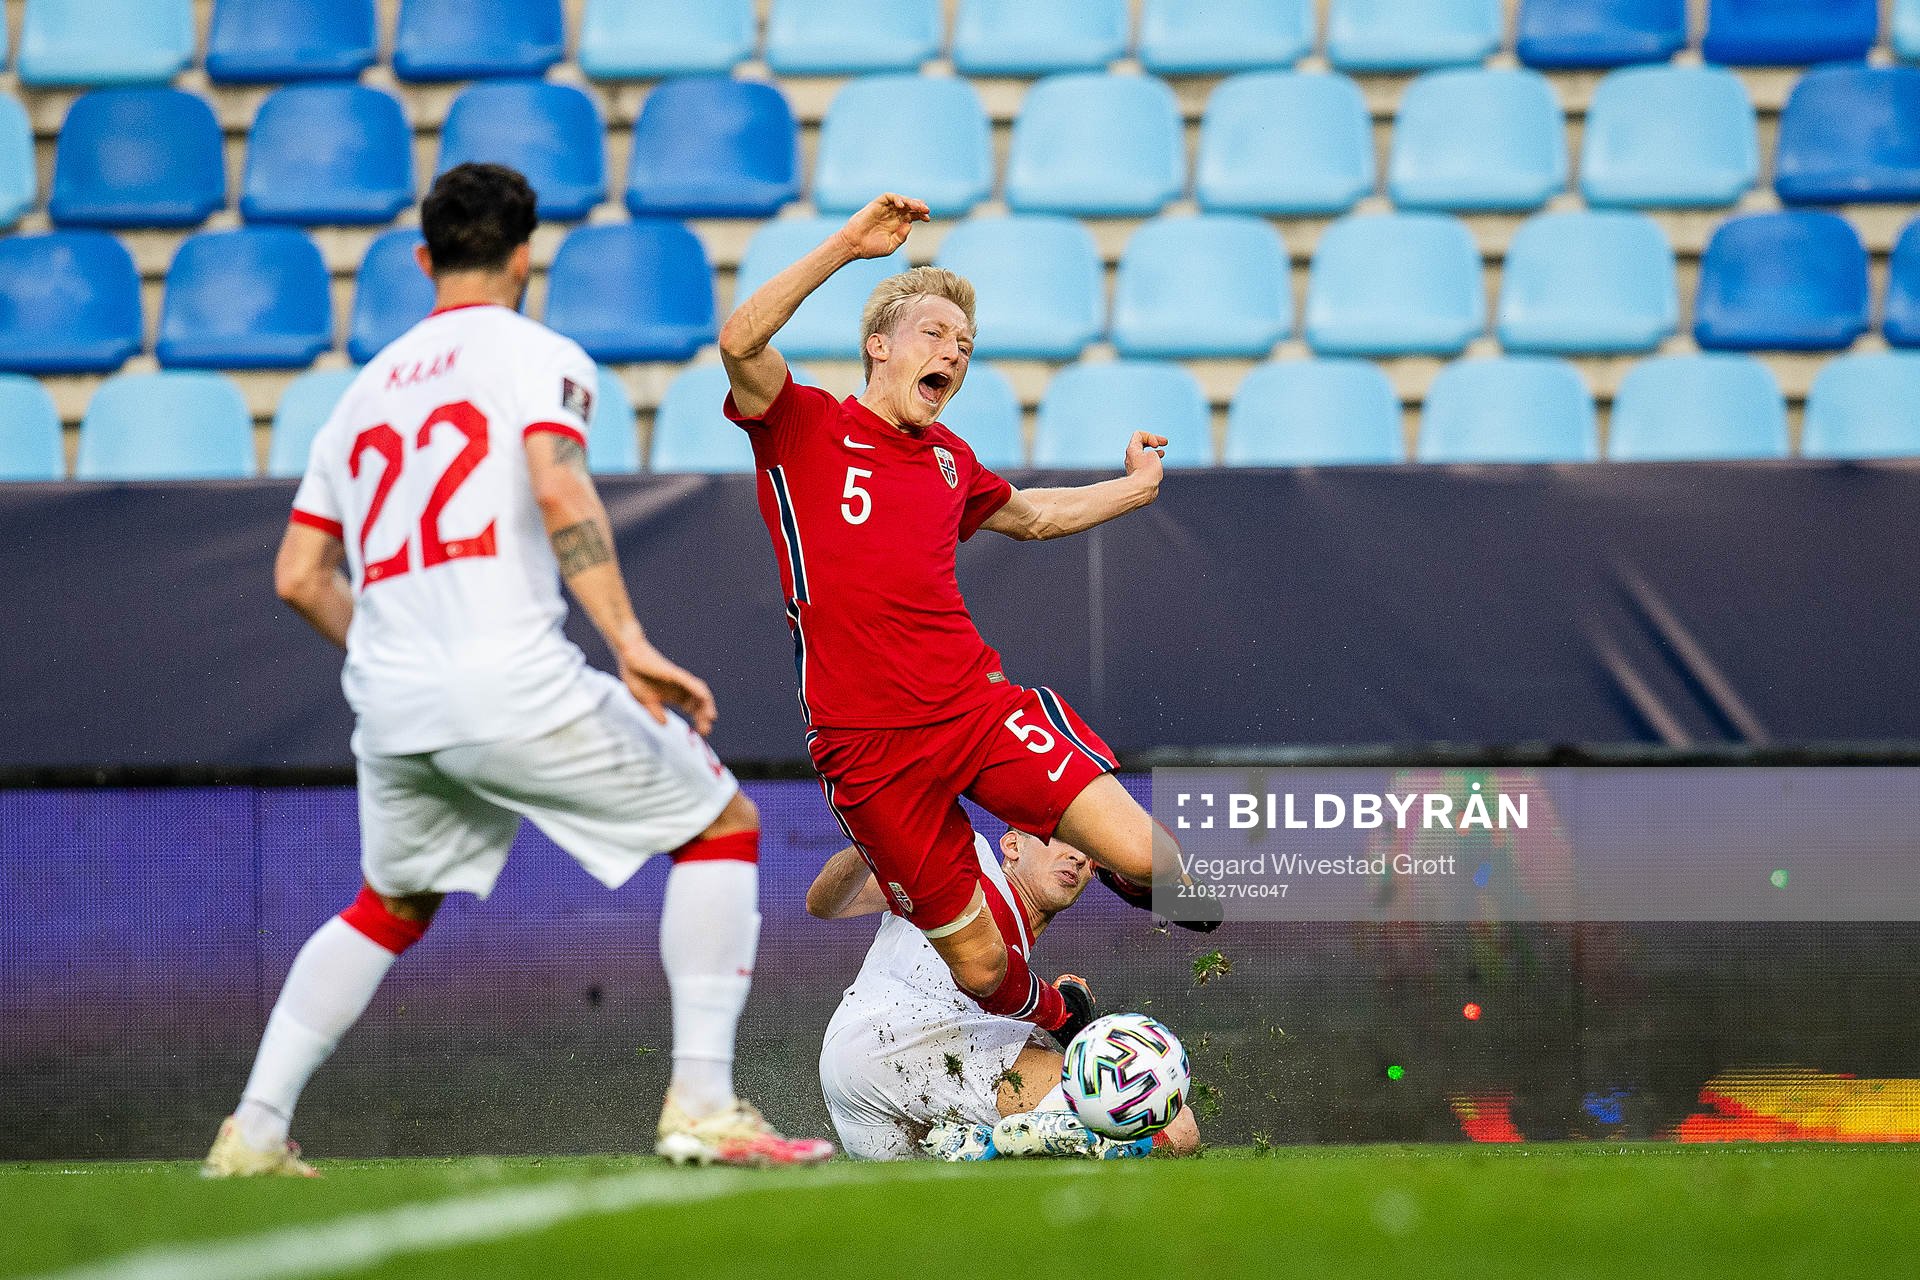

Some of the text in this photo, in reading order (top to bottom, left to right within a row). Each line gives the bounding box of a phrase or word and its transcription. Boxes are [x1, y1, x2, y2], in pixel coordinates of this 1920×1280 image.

[348, 400, 497, 589] 22
[840, 466, 873, 525] 5
[1004, 708, 1055, 754] 5
